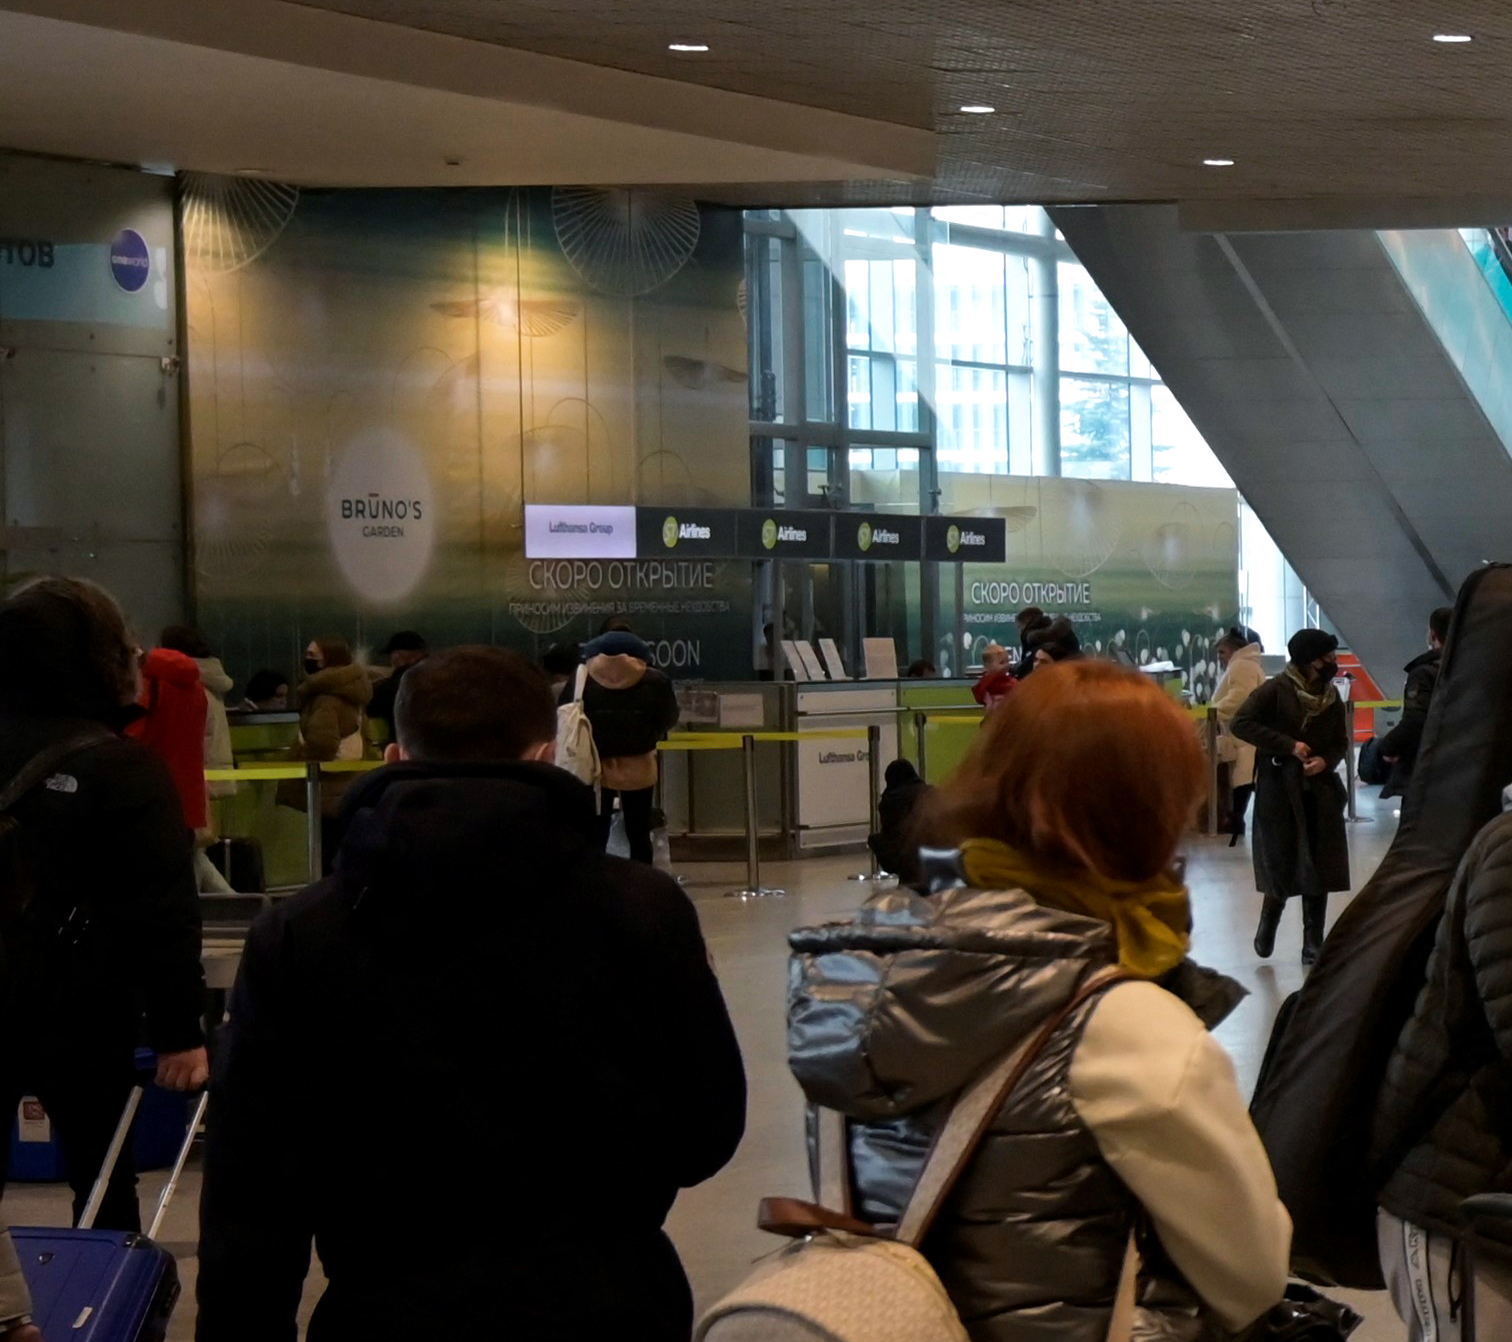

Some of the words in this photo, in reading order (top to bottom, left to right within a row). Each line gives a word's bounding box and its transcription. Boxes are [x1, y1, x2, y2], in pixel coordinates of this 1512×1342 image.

[362, 524, 404, 537] GARDEN
[550, 521, 587, 533] Lufthansa
[590, 522, 613, 534] Group
[679, 523, 710, 539] Airlines
[777, 526, 806, 542] Airlines
[872, 530, 899, 545] Airlines
[959, 531, 985, 547] Airlines
[530, 561, 602, 589] СКОРО
[608, 562, 713, 589] ОТКРЫТИЕ
[971, 582, 1019, 604] СКОРО
[1023, 582, 1091, 604] ОТКРЫТИЕ
[819, 752, 855, 764] Lufthansa
